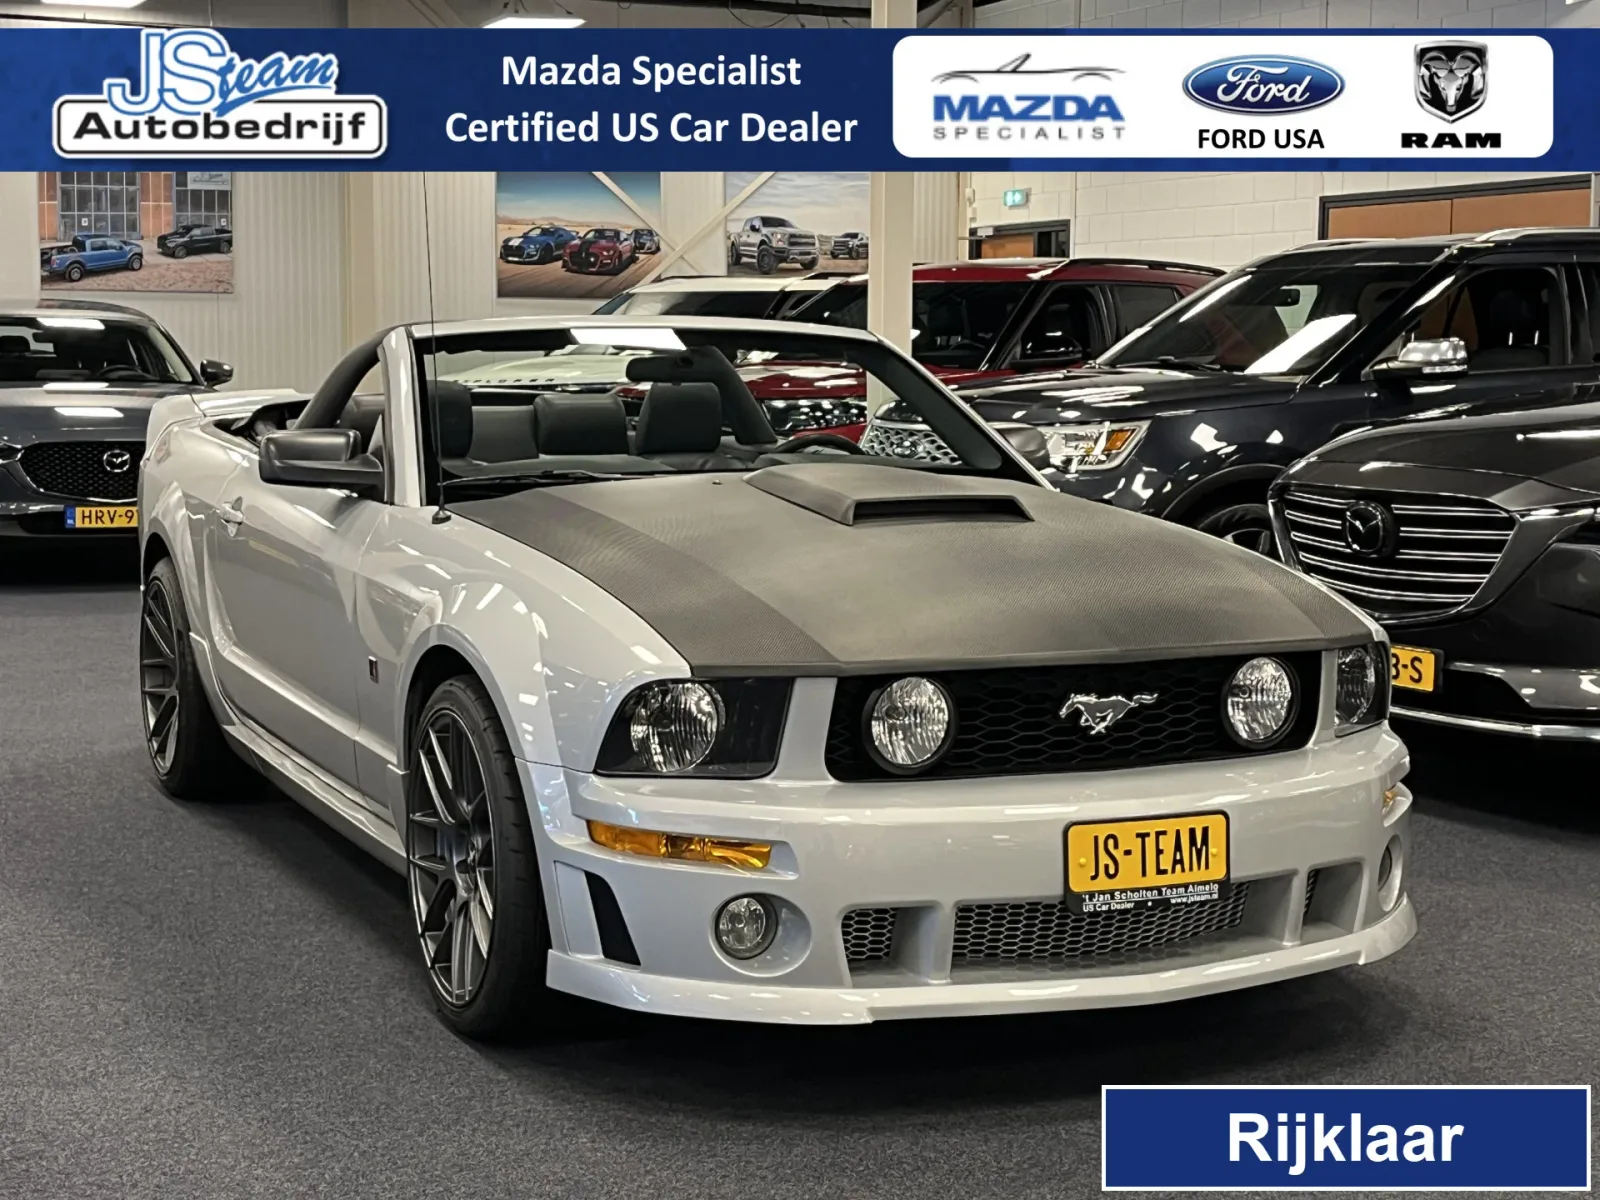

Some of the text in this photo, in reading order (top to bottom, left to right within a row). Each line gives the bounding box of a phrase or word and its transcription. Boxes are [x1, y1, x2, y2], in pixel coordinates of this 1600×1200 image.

[1090, 825, 1210, 881] JS-TEAM
[1092, 892, 1111, 902] Jan
[1114, 888, 1159, 900] Scholten
[1161, 885, 1185, 896] Team
[1083, 902, 1135, 912] US Car Dealer
